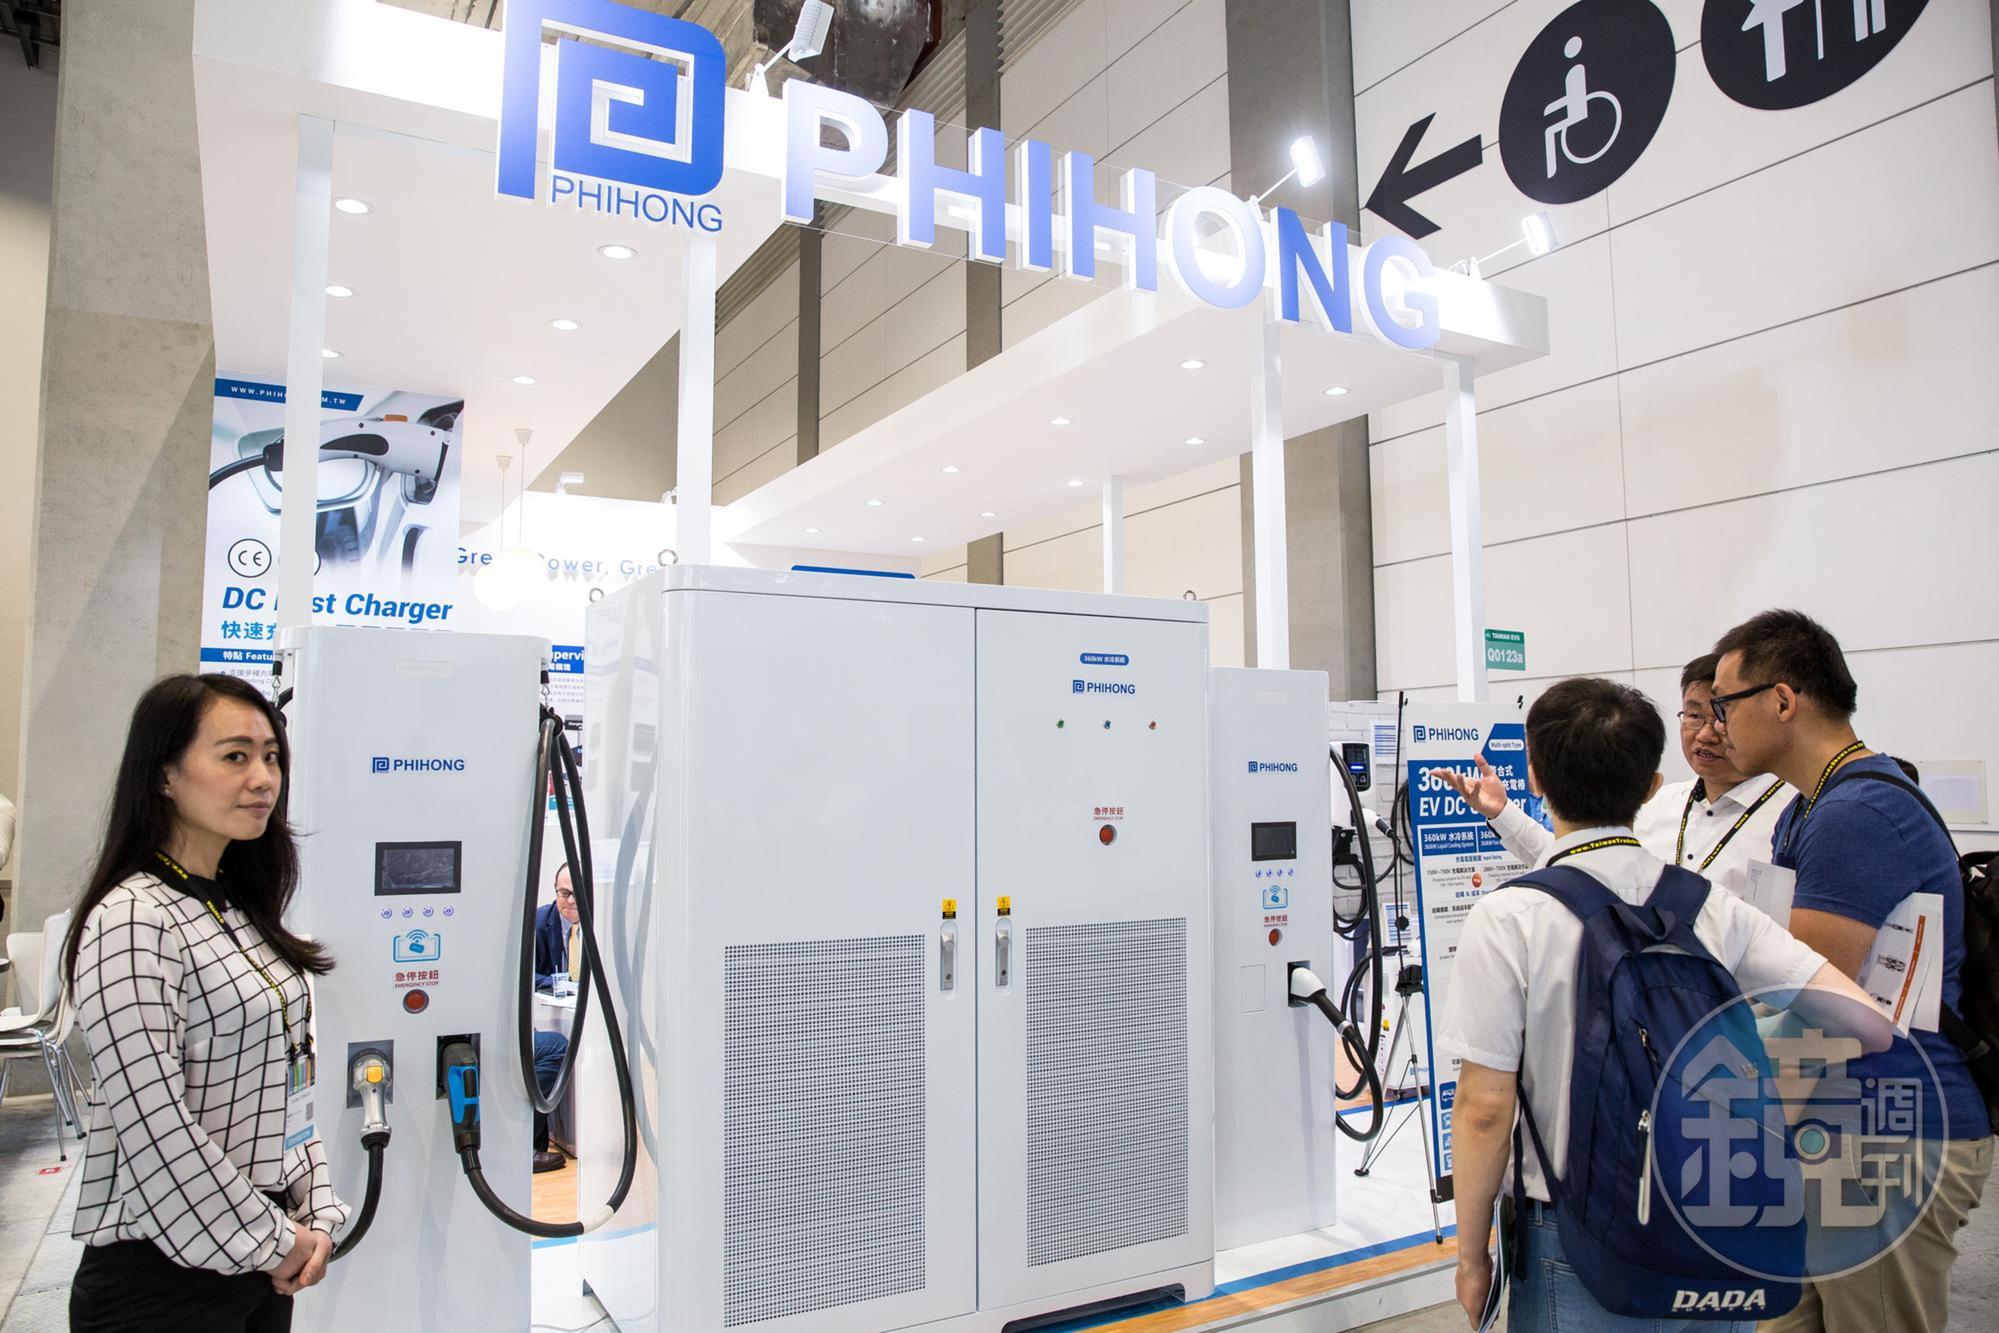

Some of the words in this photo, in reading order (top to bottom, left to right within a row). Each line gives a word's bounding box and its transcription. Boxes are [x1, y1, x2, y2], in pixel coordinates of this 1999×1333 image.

[551, 174, 723, 233] PHIHONG
[781, 78, 1441, 349] PHIHONG
[222, 587, 266, 610] DC
[345, 593, 453, 624] Charger
[551, 649, 584, 662] pervi
[1487, 647, 1523, 664] Q0123a
[1087, 682, 1136, 694] PHIHONG
[1429, 728, 1479, 741] PHIHONG
[394, 759, 465, 771] PHIHONG
[1259, 762, 1298, 772] PHIHONG
[1420, 797, 1440, 816] EV
[1444, 796, 1466, 816] DC
[1424, 832, 1446, 842] 360kW
[395, 969, 439, 982] 急停按鈕
[1672, 1288, 1766, 1308] DADA
